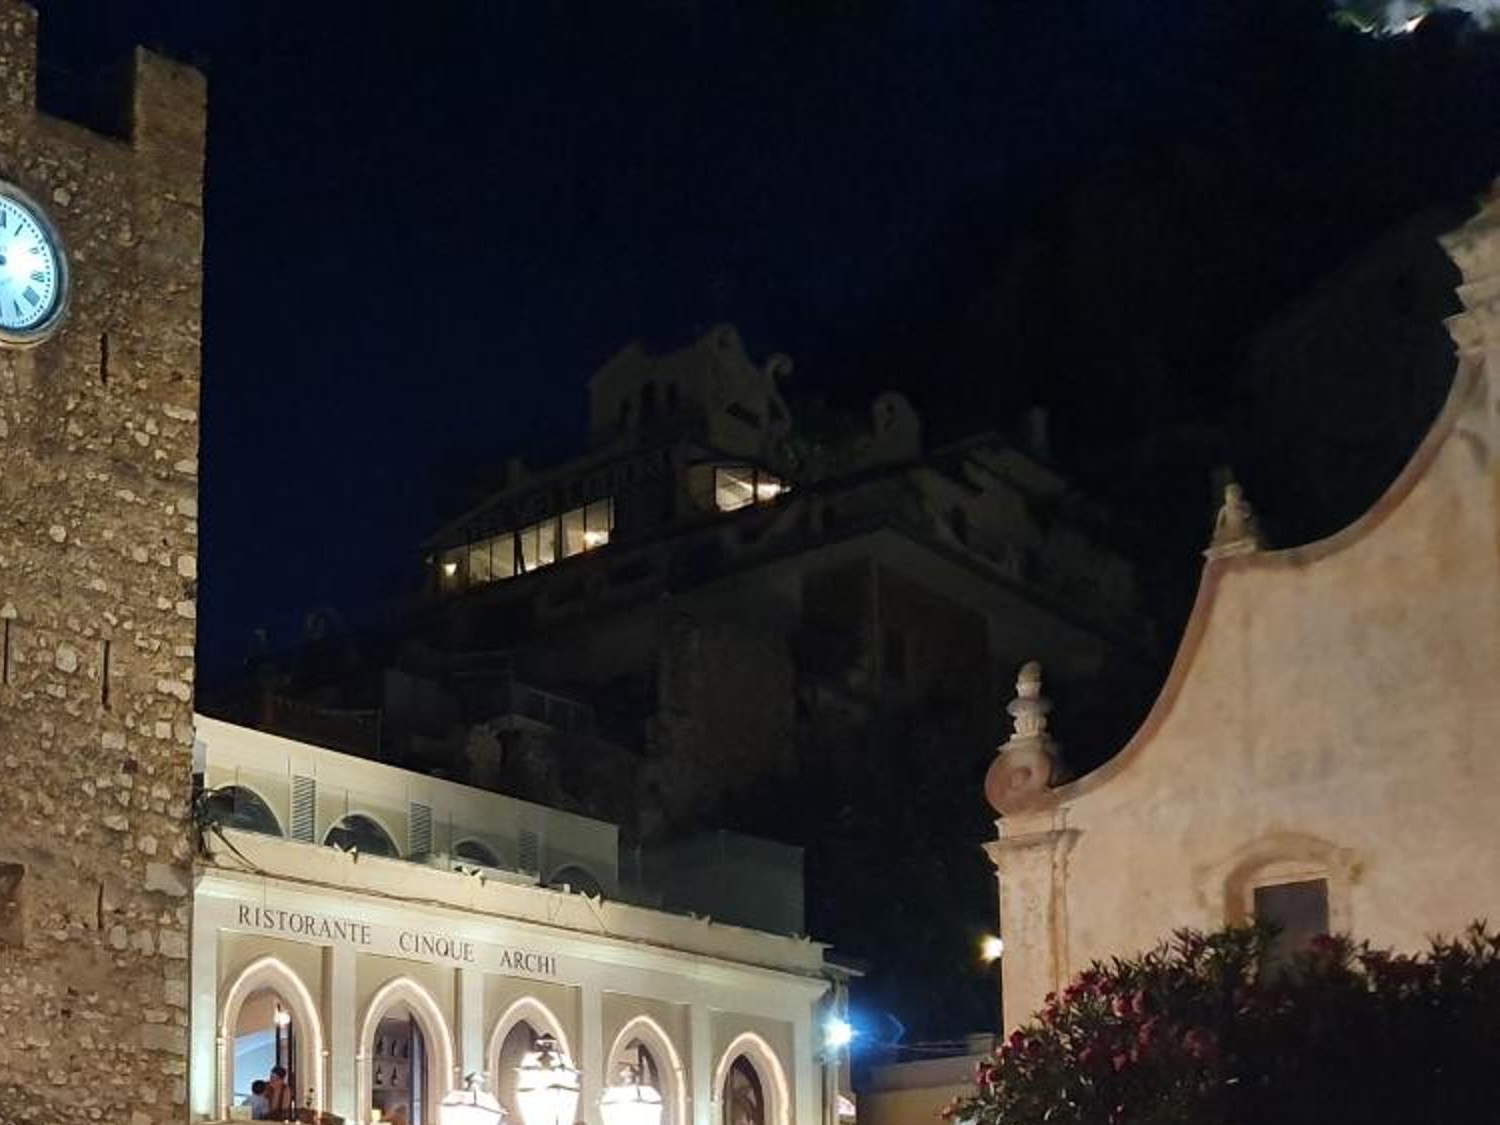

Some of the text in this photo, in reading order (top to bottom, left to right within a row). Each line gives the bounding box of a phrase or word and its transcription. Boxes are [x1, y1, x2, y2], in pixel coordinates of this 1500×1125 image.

[238, 904, 557, 976] RISTORANTE CINQUE ARCHI
